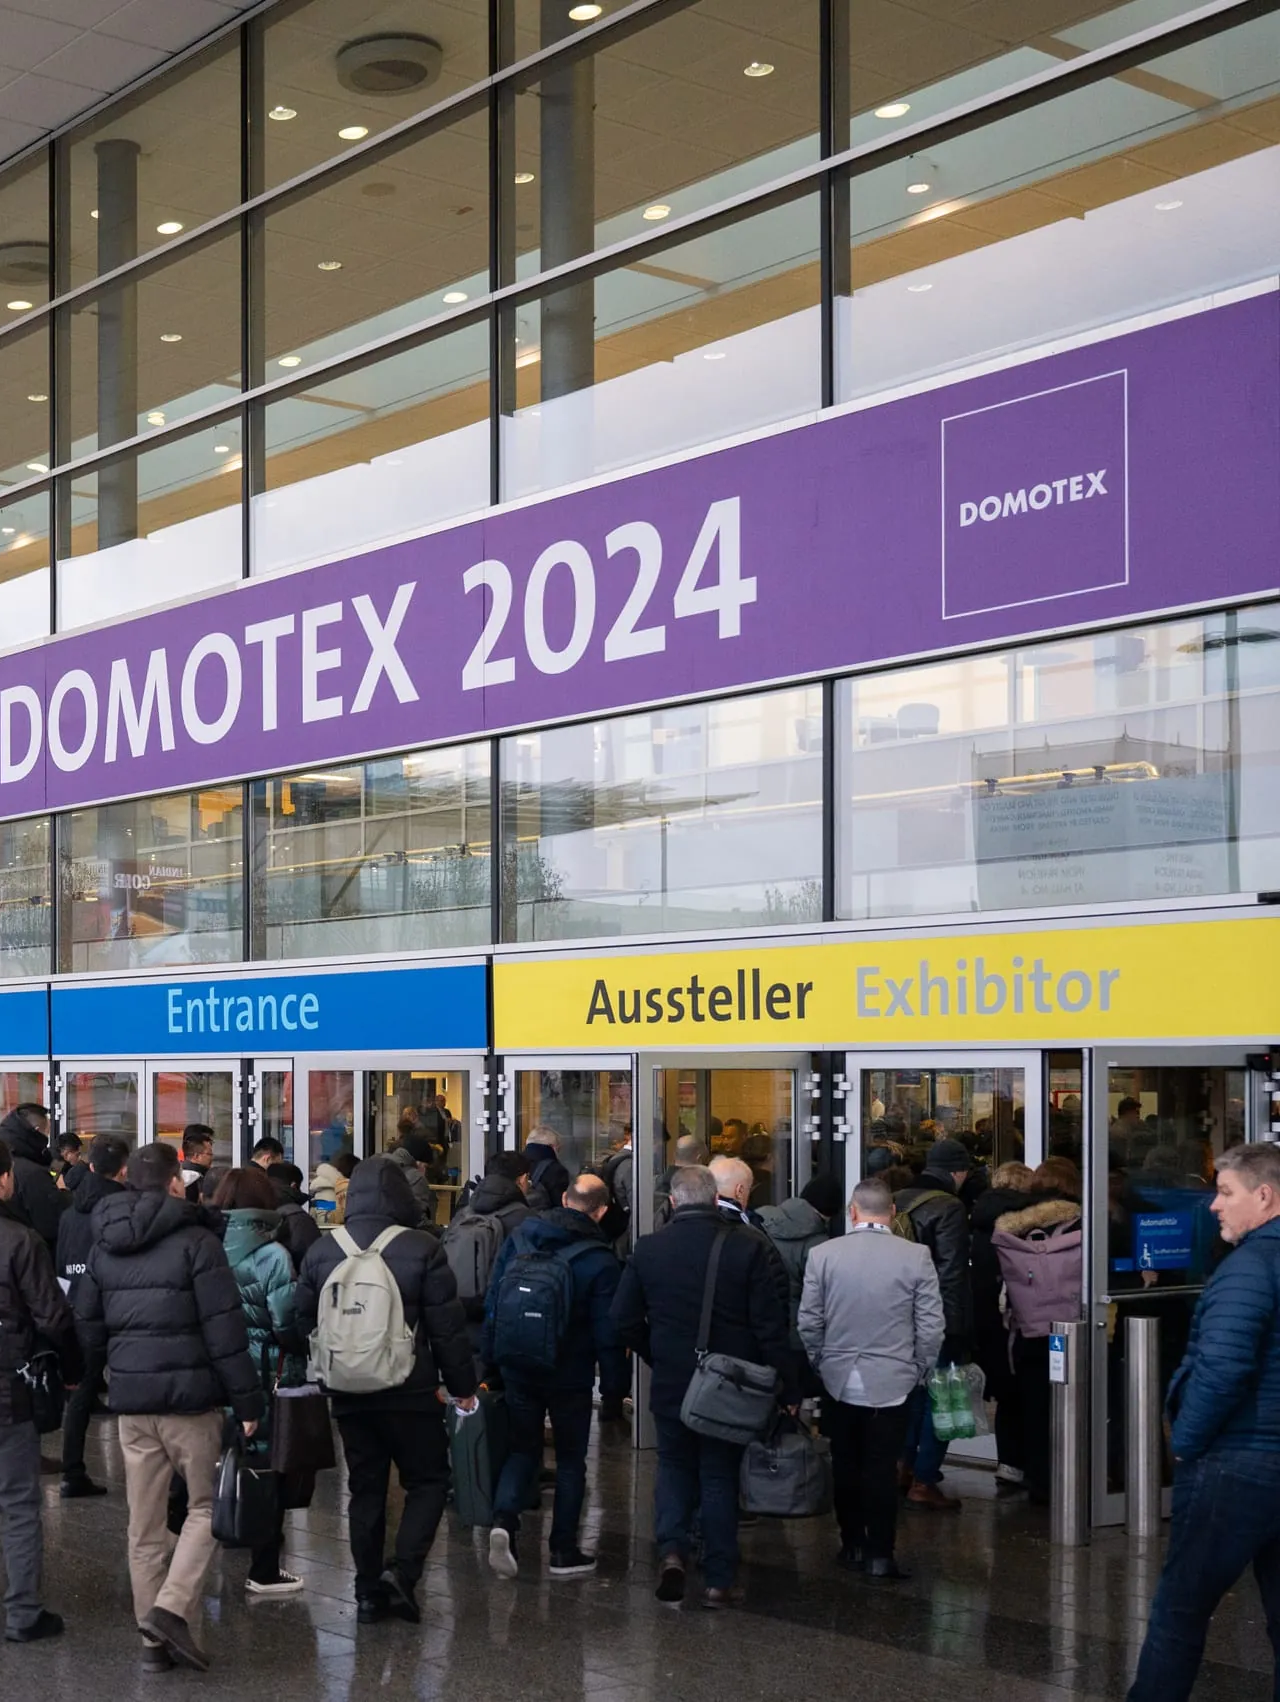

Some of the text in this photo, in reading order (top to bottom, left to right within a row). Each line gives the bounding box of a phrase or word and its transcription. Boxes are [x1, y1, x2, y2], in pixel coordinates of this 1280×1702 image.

[959, 468, 1108, 527] DOMOTEX
[0, 580, 420, 785] DOMOTEX
[461, 496, 758, 692] 2024
[167, 986, 320, 1034] Entrance
[585, 956, 1121, 1026] Aussteller Exhibitor
